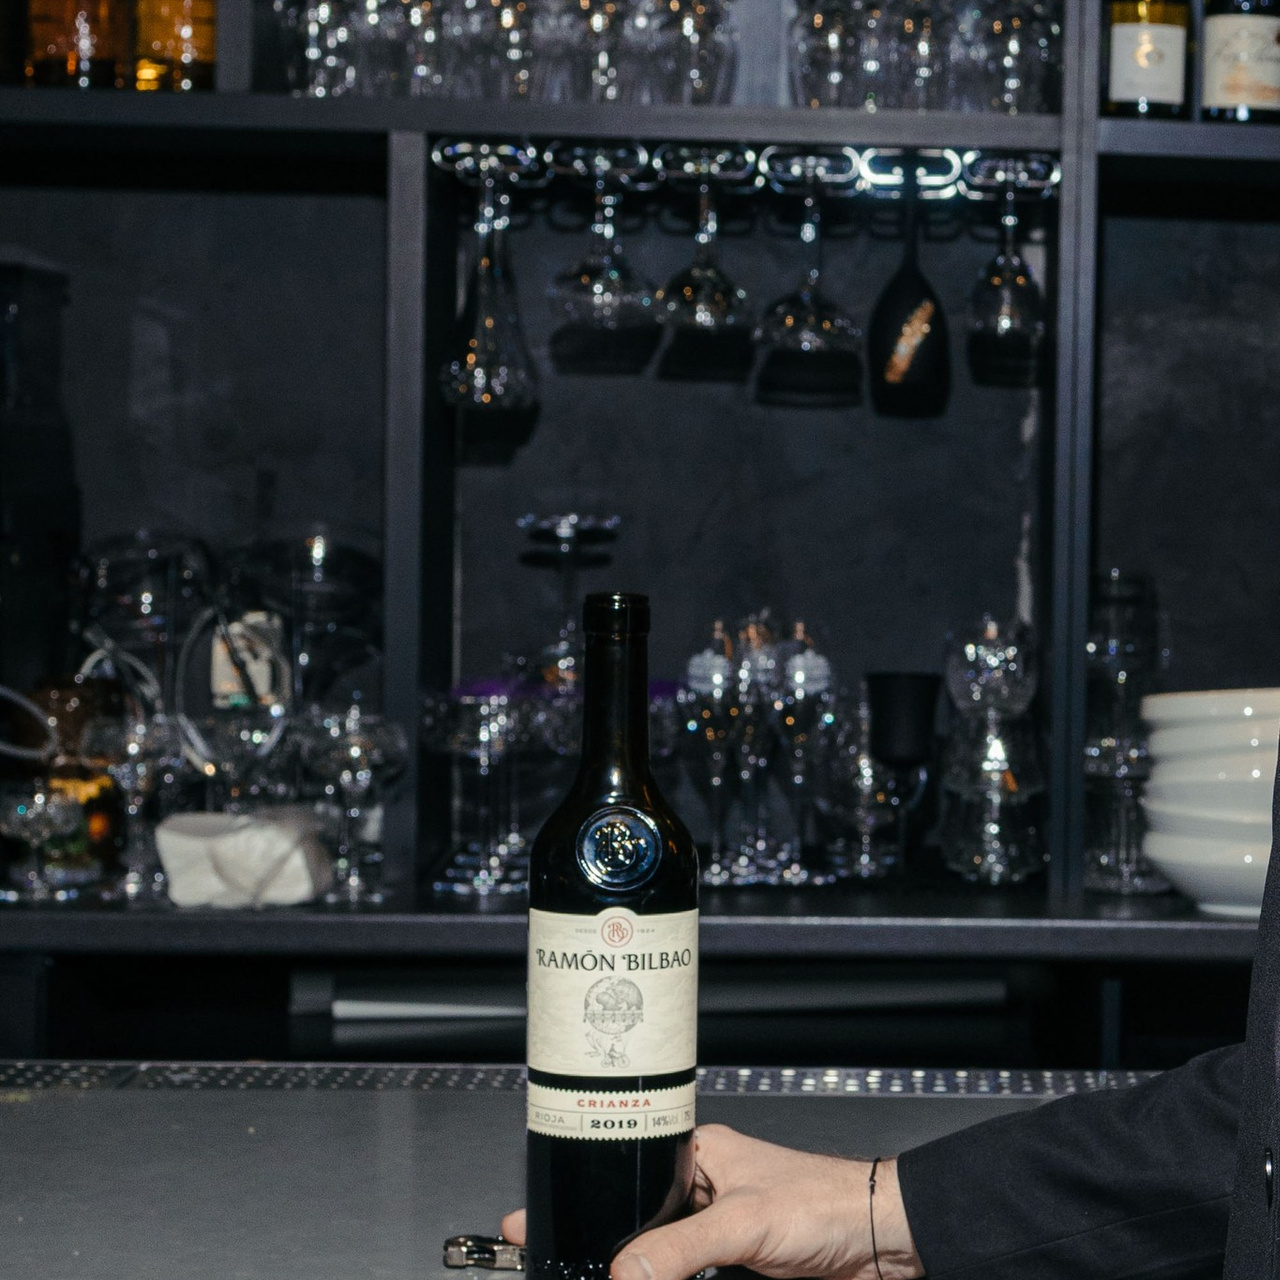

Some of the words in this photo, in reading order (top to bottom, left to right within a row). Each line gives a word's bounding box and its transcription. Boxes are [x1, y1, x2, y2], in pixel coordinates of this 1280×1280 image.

[621, 948, 692, 971] BILBAO
[577, 1099, 652, 1108] CRIANZA
[534, 1111, 565, 1124] RIOJA
[590, 1119, 638, 1130] 2019
